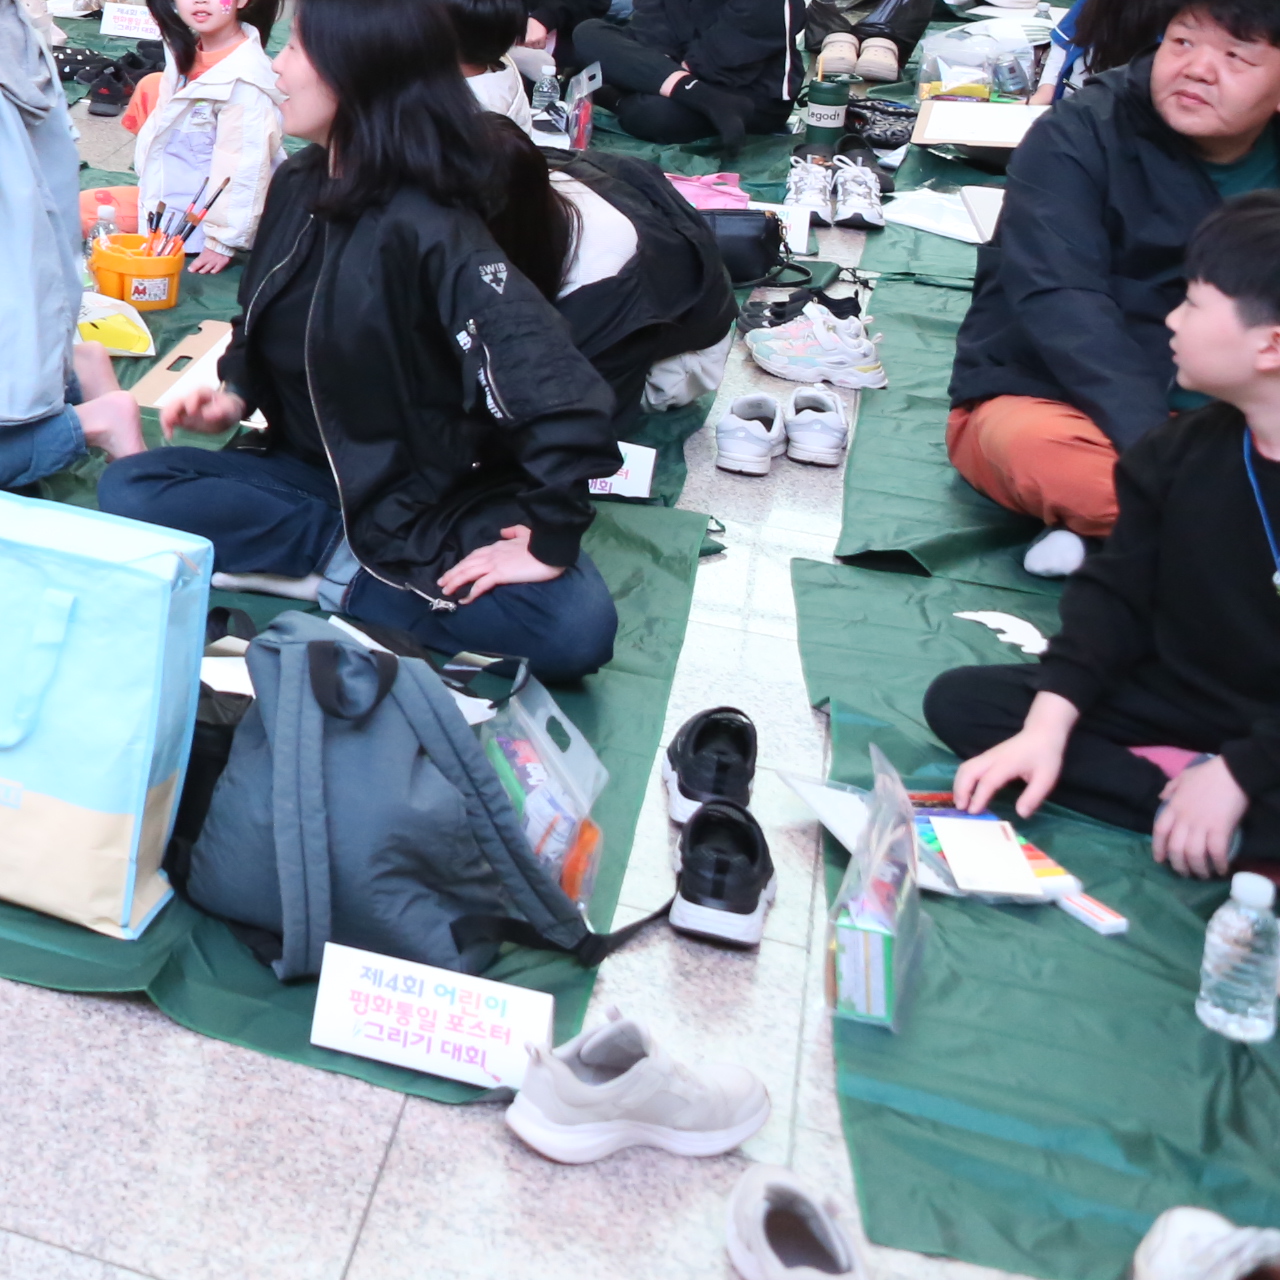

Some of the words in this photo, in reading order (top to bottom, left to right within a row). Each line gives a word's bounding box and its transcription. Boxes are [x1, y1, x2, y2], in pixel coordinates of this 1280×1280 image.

[117, 8, 138, 16] 제4회
[112, 15, 142, 26] 평화통일
[117, 24, 140, 32] 그리기
[141, 27, 157, 36] 대회
[478, 262, 507, 276] SWIB
[132, 285, 147, 297] A4
[359, 965, 425, 998] 제4회
[433, 983, 507, 1018] 어린이
[349, 989, 438, 1034] 평화통일
[444, 1013, 511, 1046] 포스터
[364, 1021, 432, 1055] 그리기
[440, 1039, 486, 1068] 대회
